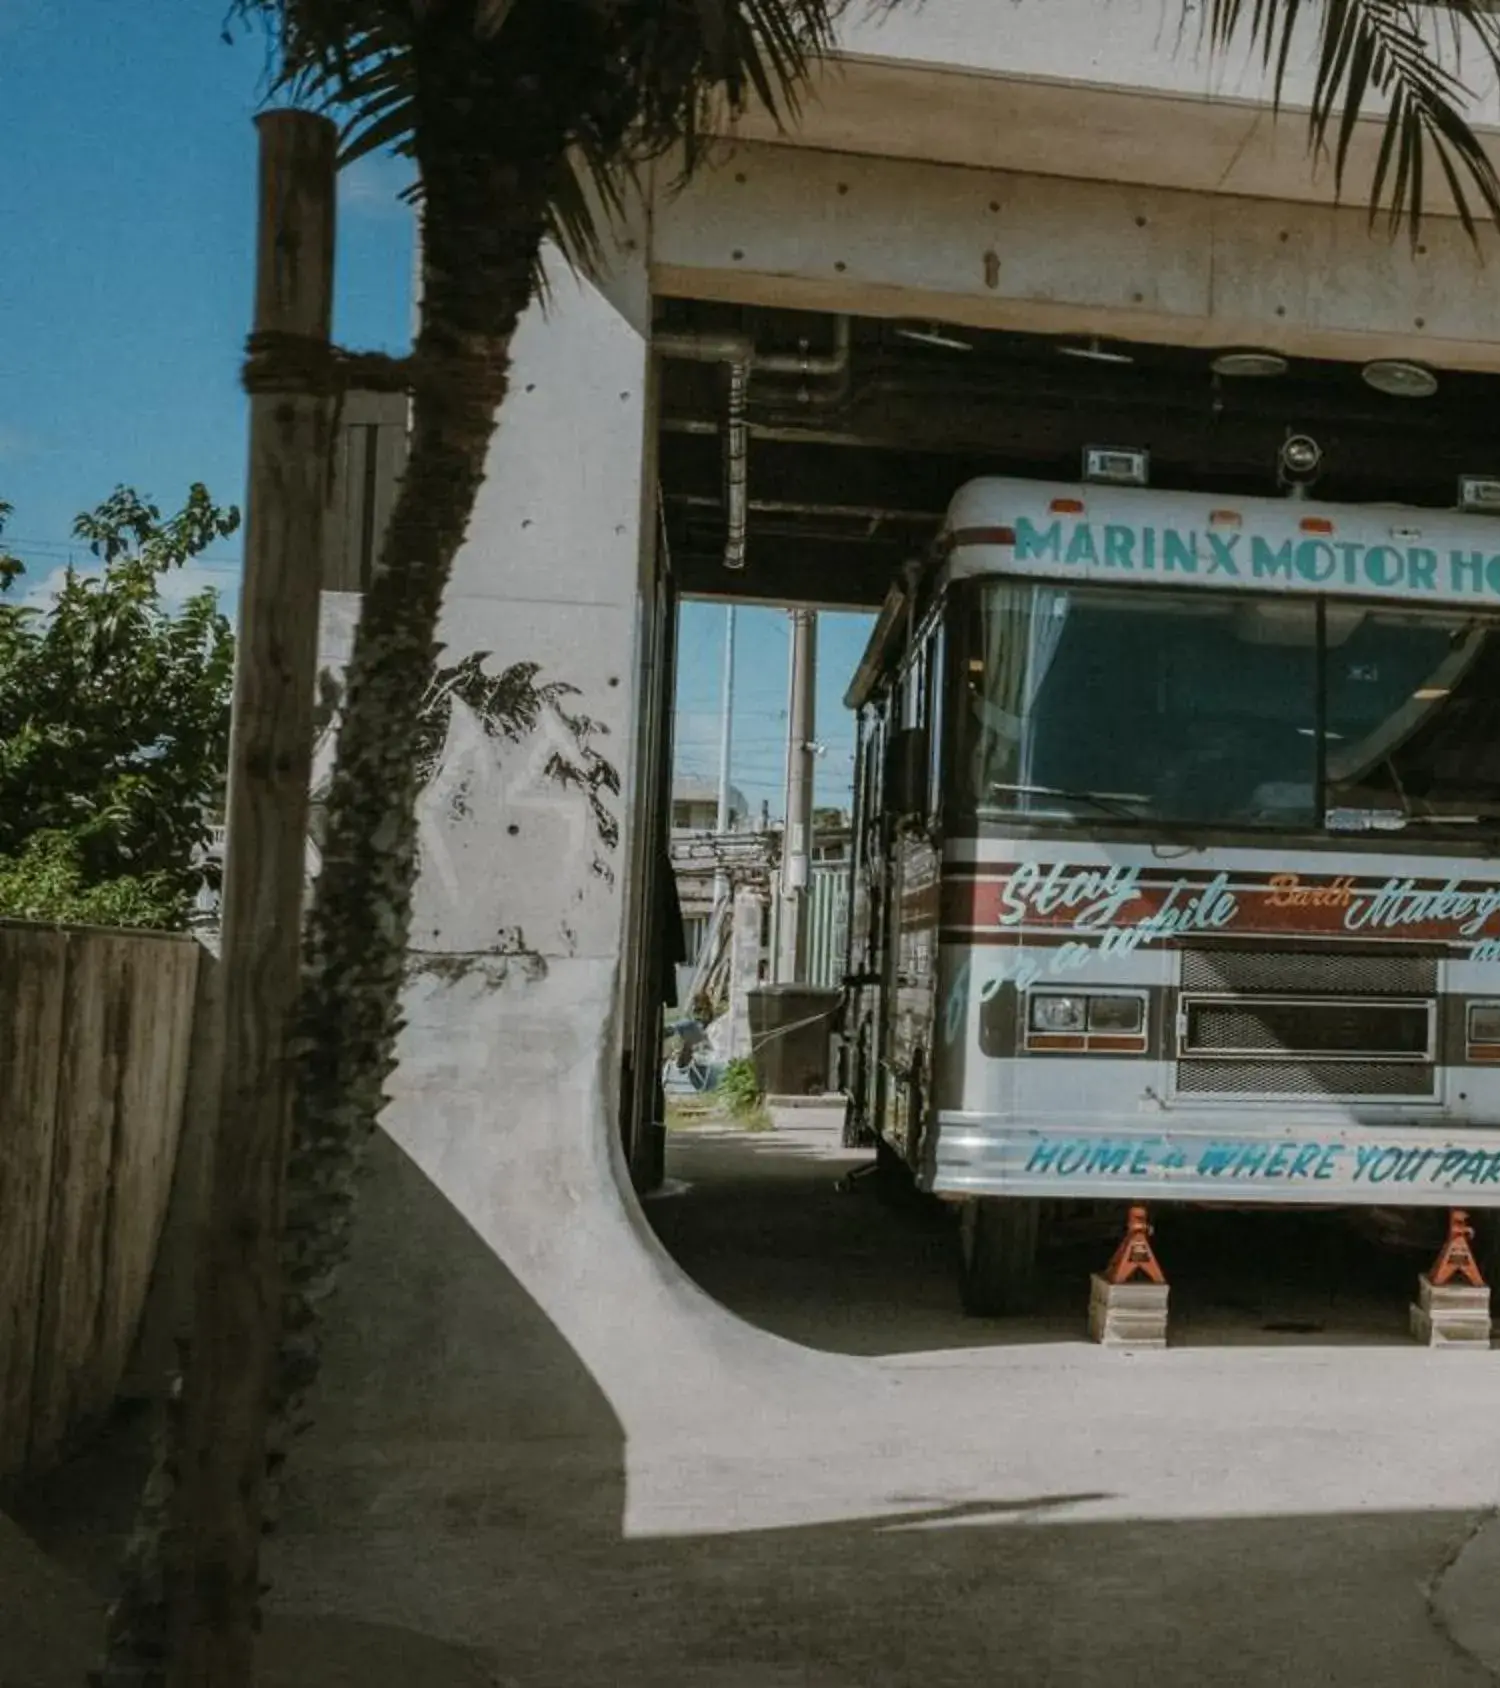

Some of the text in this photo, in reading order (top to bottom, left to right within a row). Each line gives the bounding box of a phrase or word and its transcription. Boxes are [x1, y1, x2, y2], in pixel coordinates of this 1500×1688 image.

[1013, 516, 1242, 576] MARINX
[1250, 536, 1438, 591] MOTOR
[999, 861, 1142, 932] Stay
[1100, 871, 1239, 961] while
[1264, 874, 1356, 907] Barth
[1343, 877, 1478, 930] Make
[1024, 1138, 1162, 1176] HOME
[1197, 1142, 1345, 1179] WHERE
[1353, 1145, 1432, 1183] YOU
